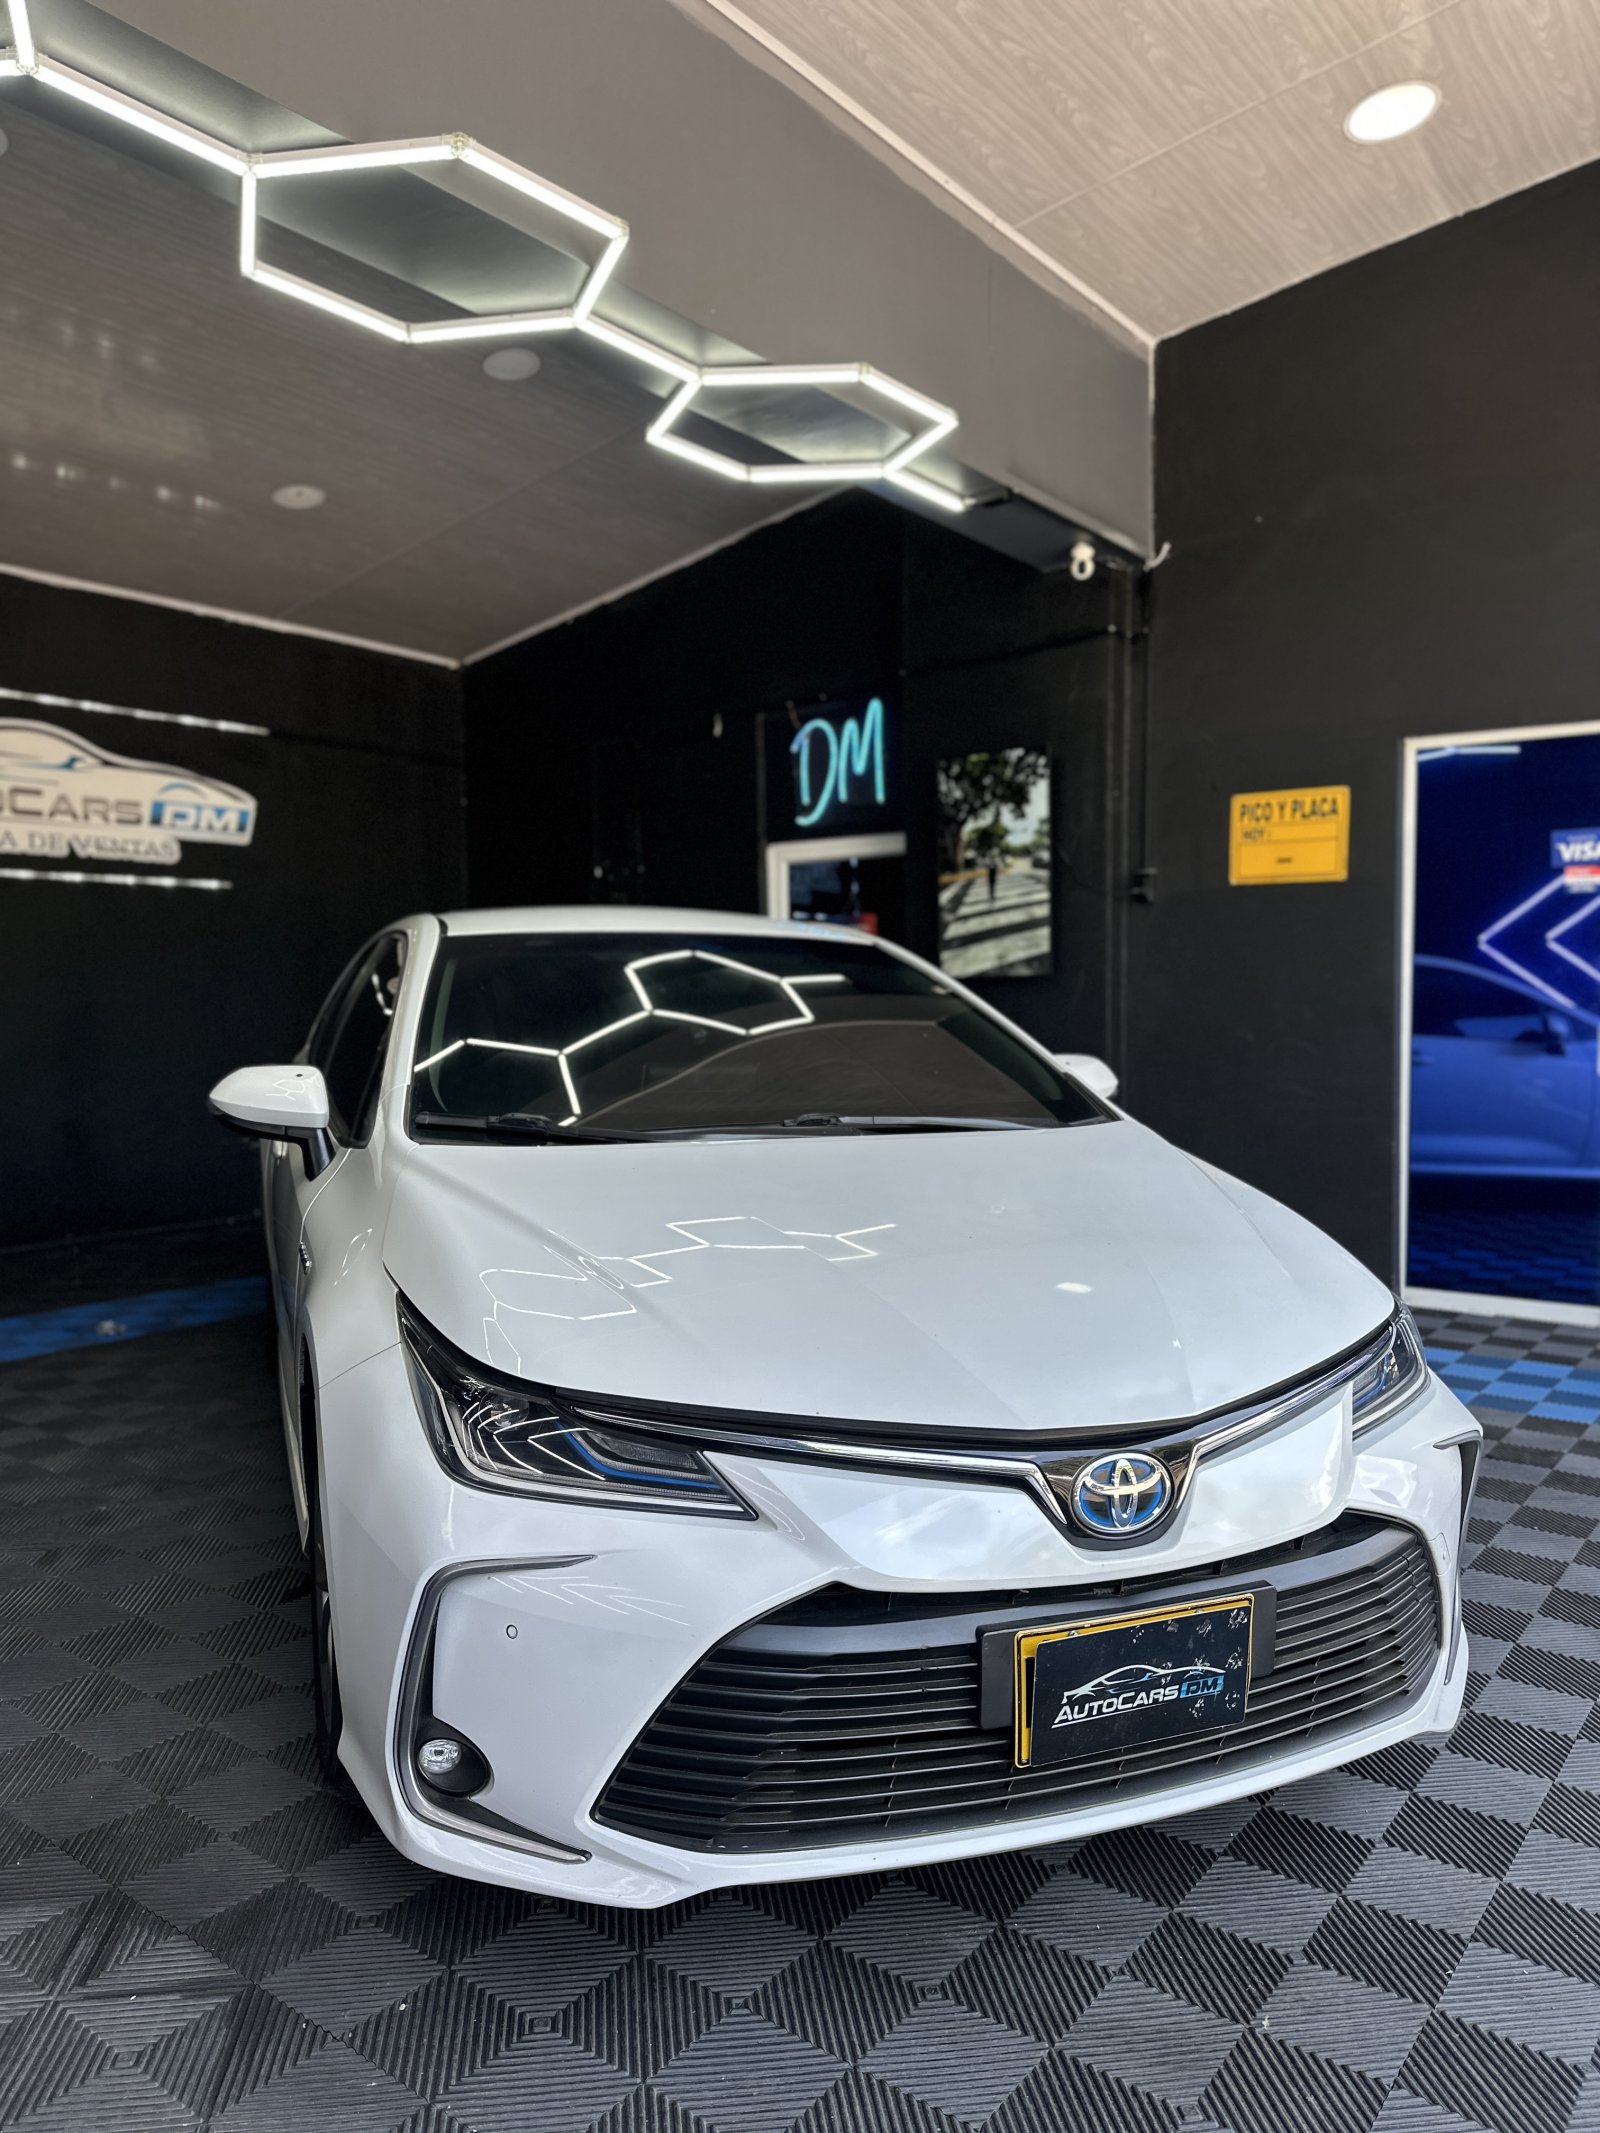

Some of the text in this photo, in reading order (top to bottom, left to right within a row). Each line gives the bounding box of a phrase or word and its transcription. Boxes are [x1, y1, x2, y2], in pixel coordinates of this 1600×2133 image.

[790, 698, 885, 826] DM
[0, 786, 142, 825] CARS
[1240, 797, 1338, 822] PICO Y PLACA
[27, 831, 65, 851] DE
[71, 833, 174, 856] VENTAS
